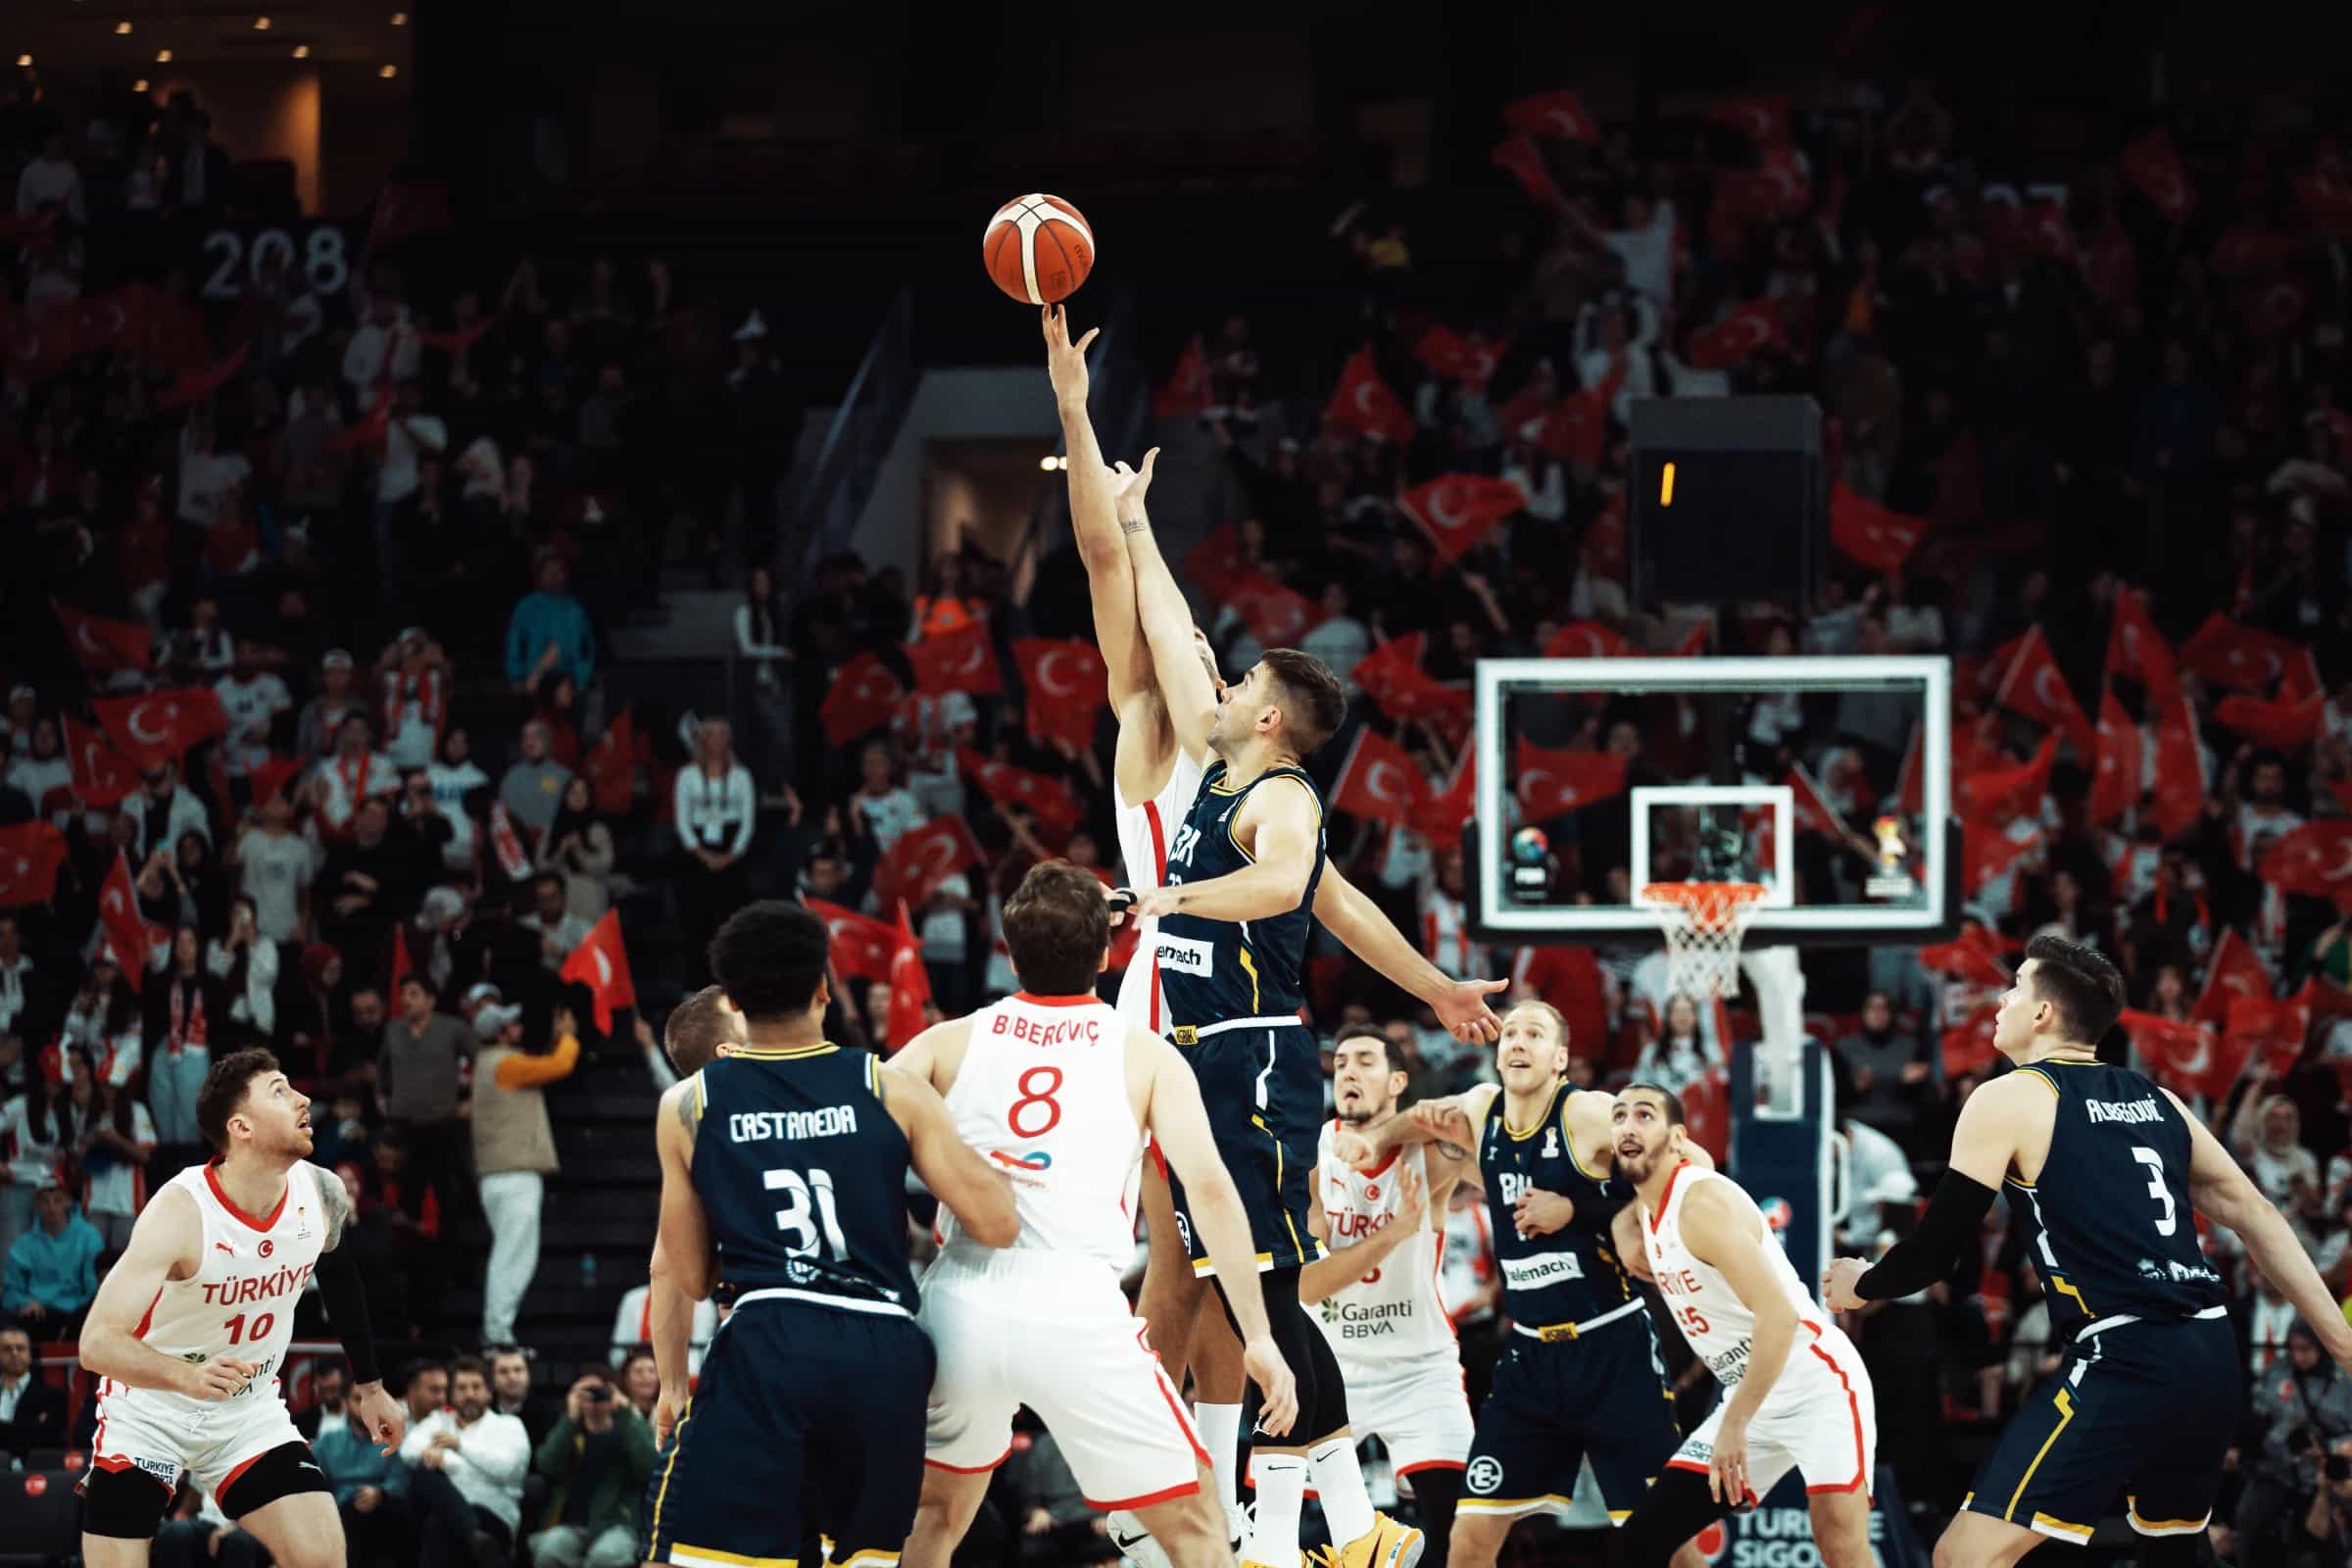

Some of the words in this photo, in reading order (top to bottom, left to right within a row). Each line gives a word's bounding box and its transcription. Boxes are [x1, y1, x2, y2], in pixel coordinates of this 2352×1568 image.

[202, 227, 348, 298] 208
[729, 1104, 858, 1143] CASTANEDA
[1008, 1066, 1063, 1139] 8
[762, 1168, 850, 1262] 31
[2131, 1147, 2177, 1237] 3
[223, 1312, 274, 1346] 10
[1342, 1299, 1412, 1322] Garanti
[1343, 1321, 1395, 1339] BBVA
